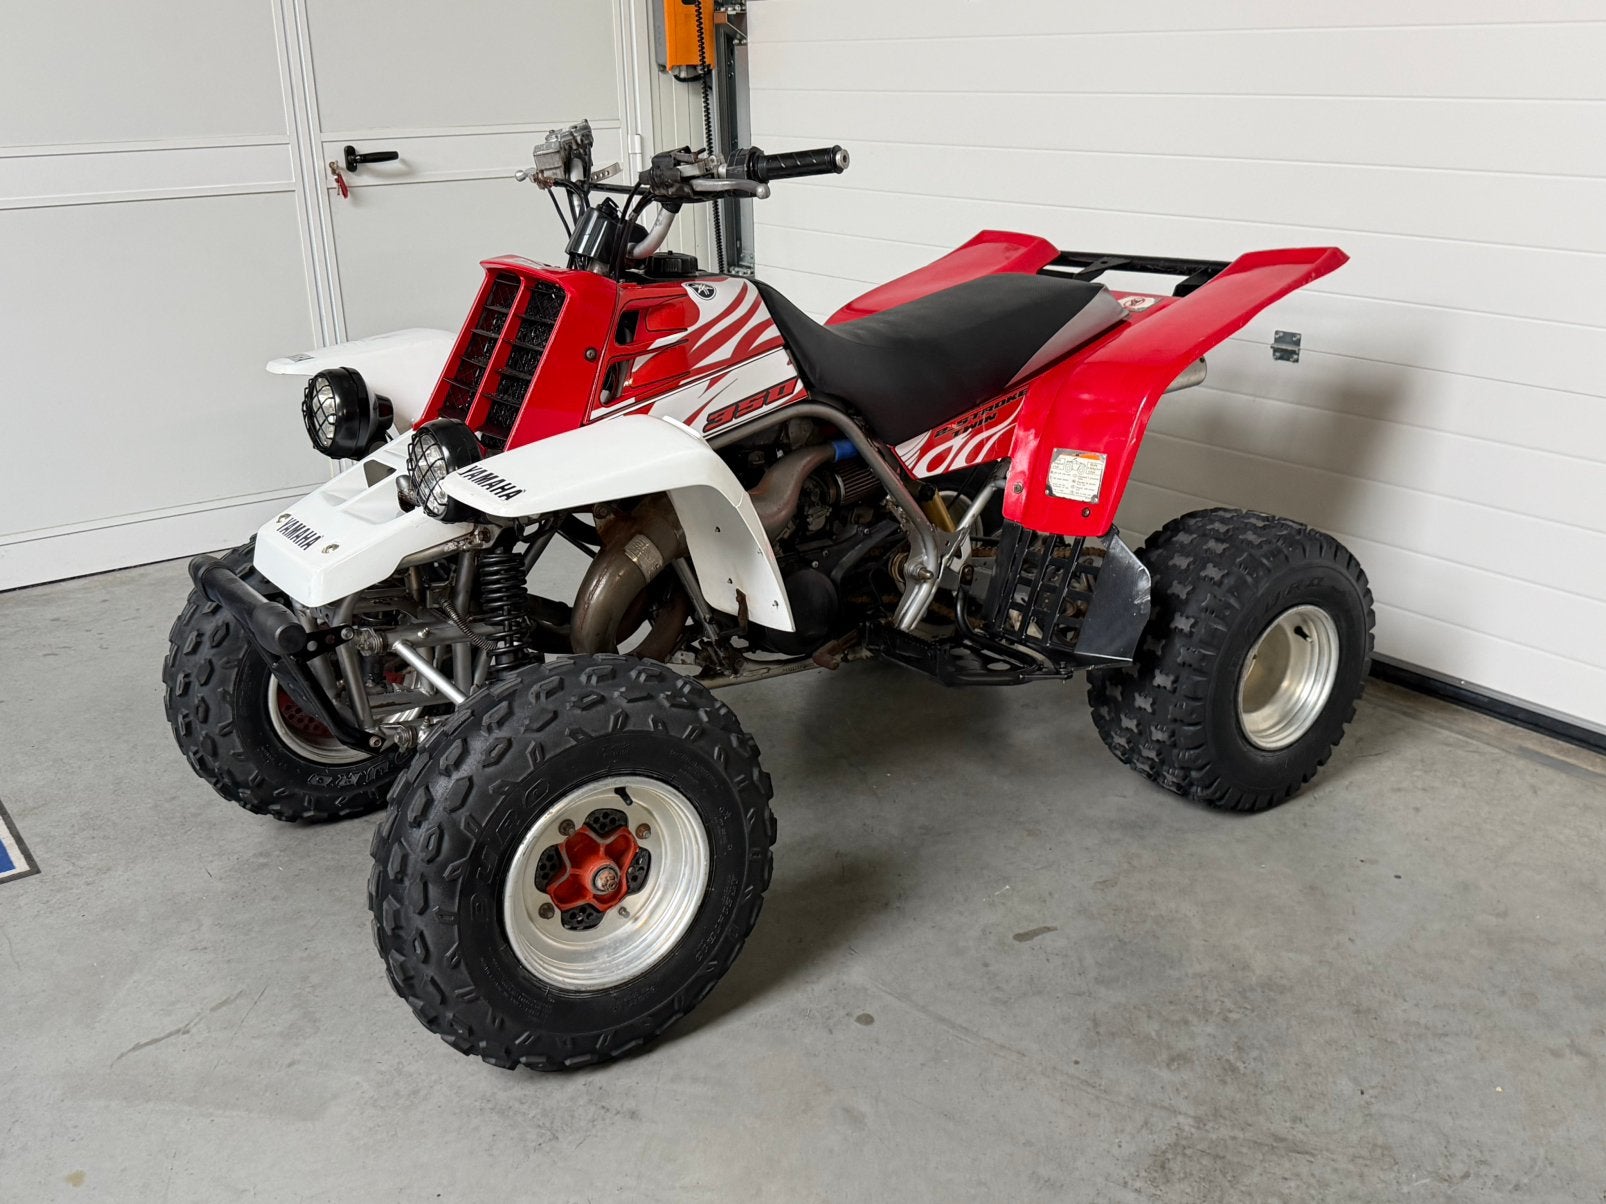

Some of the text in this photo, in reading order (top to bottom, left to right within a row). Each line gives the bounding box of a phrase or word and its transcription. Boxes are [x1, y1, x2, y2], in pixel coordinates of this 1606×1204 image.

[702, 375, 799, 433] 350
[953, 411, 998, 438] TWIN
[457, 465, 523, 501] YAMAHA
[276, 517, 322, 551] YAMAHA
[308, 759, 391, 787] URO
[470, 778, 550, 921] DURO
